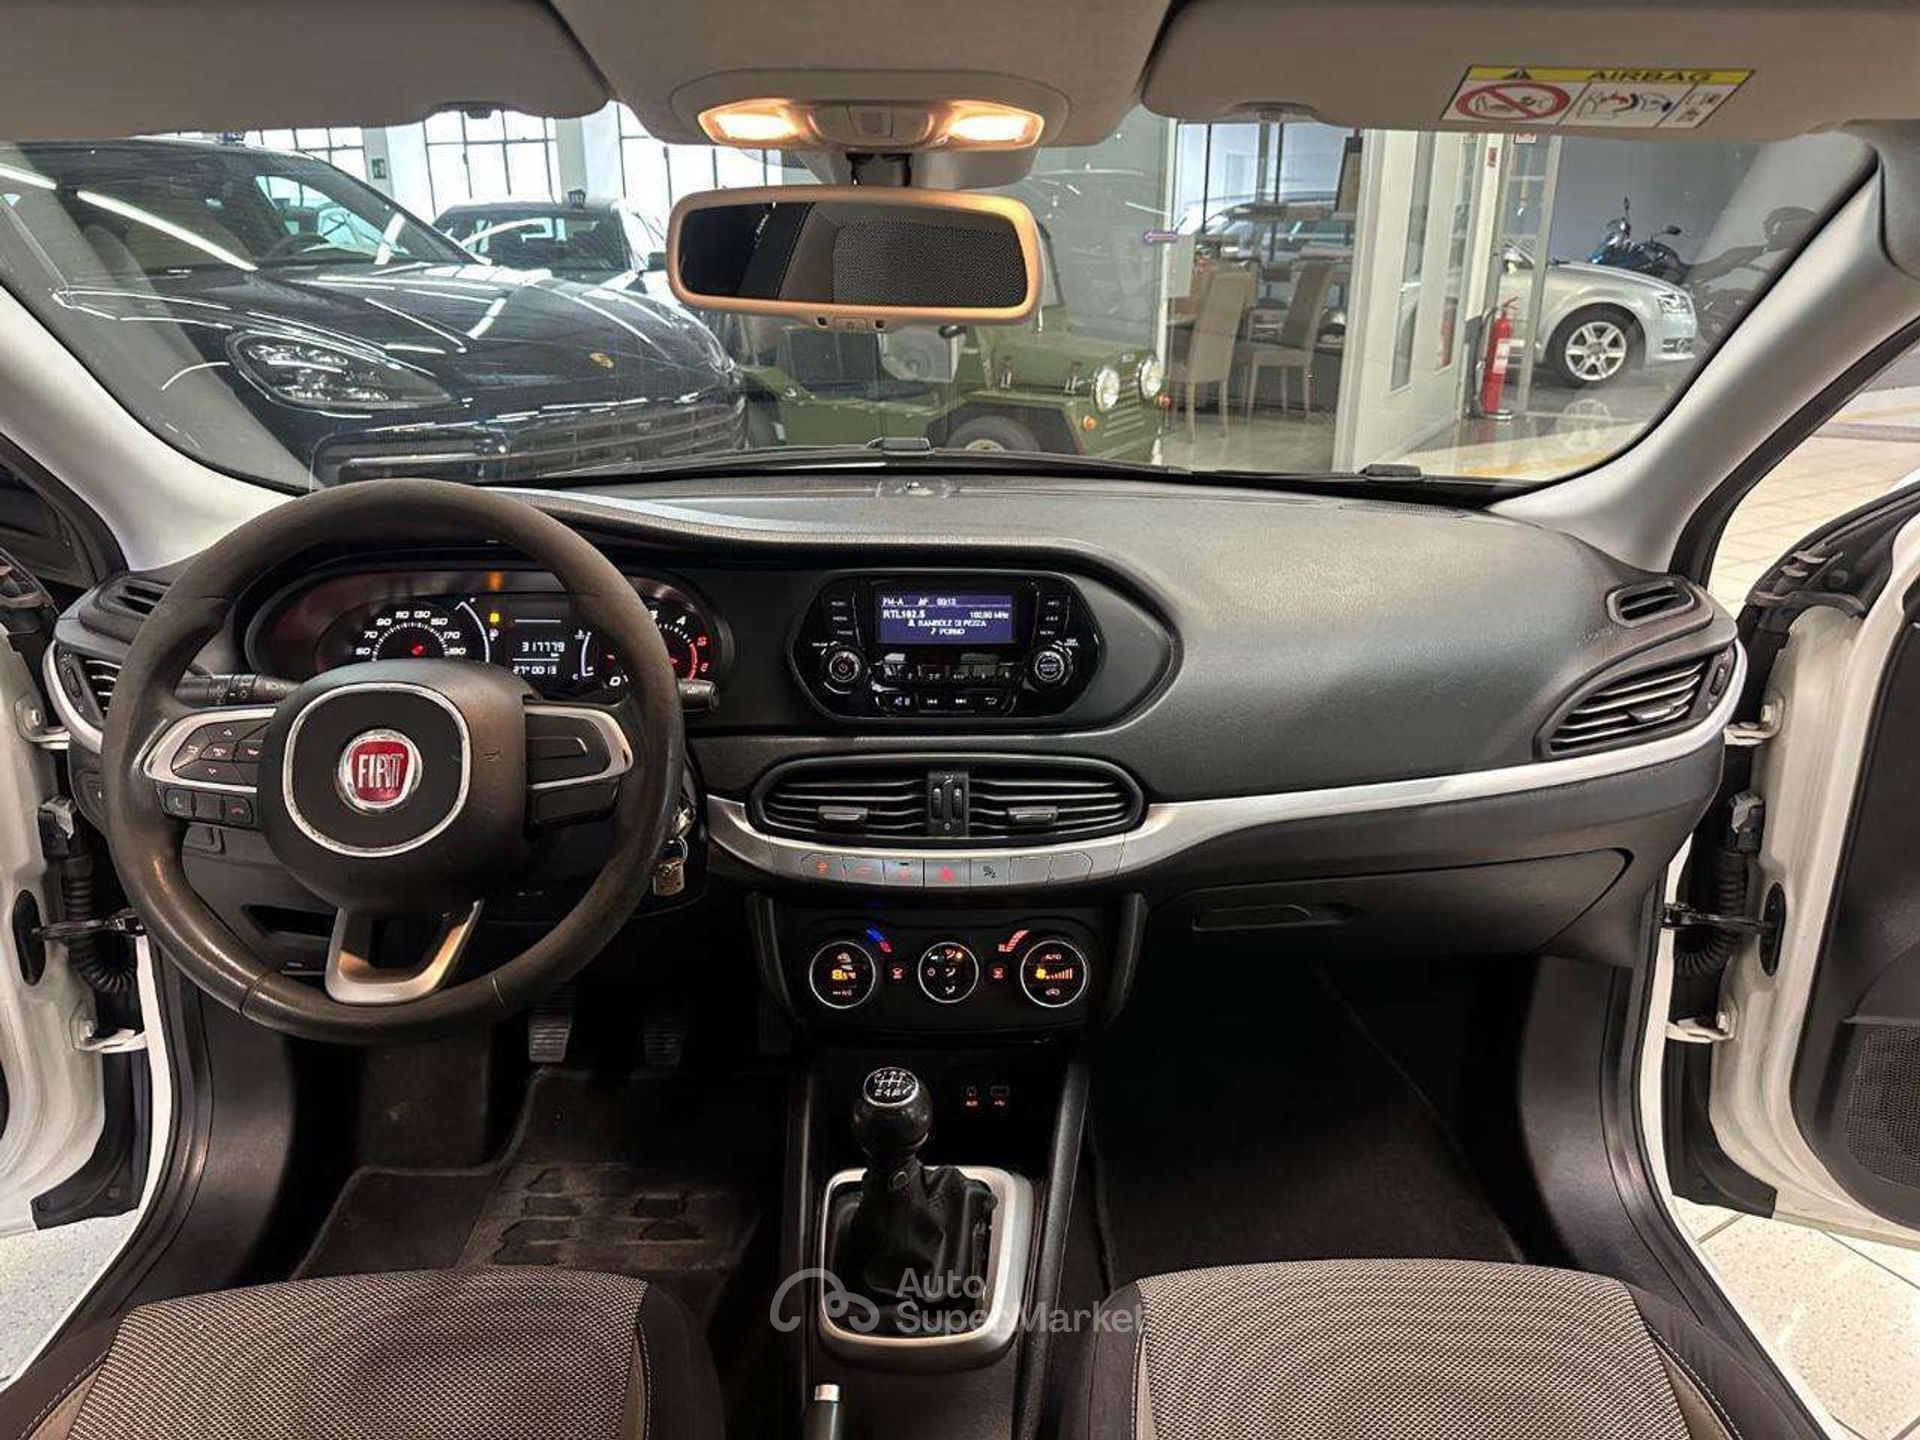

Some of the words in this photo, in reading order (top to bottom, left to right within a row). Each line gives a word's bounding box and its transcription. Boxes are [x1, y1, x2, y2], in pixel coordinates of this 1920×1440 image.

[1586, 70, 1712, 82] AIRBAG
[363, 630, 379, 640] 70
[443, 630, 461, 640] 170
[609, 675, 622, 687] 0
[357, 752, 405, 789] FIAT
